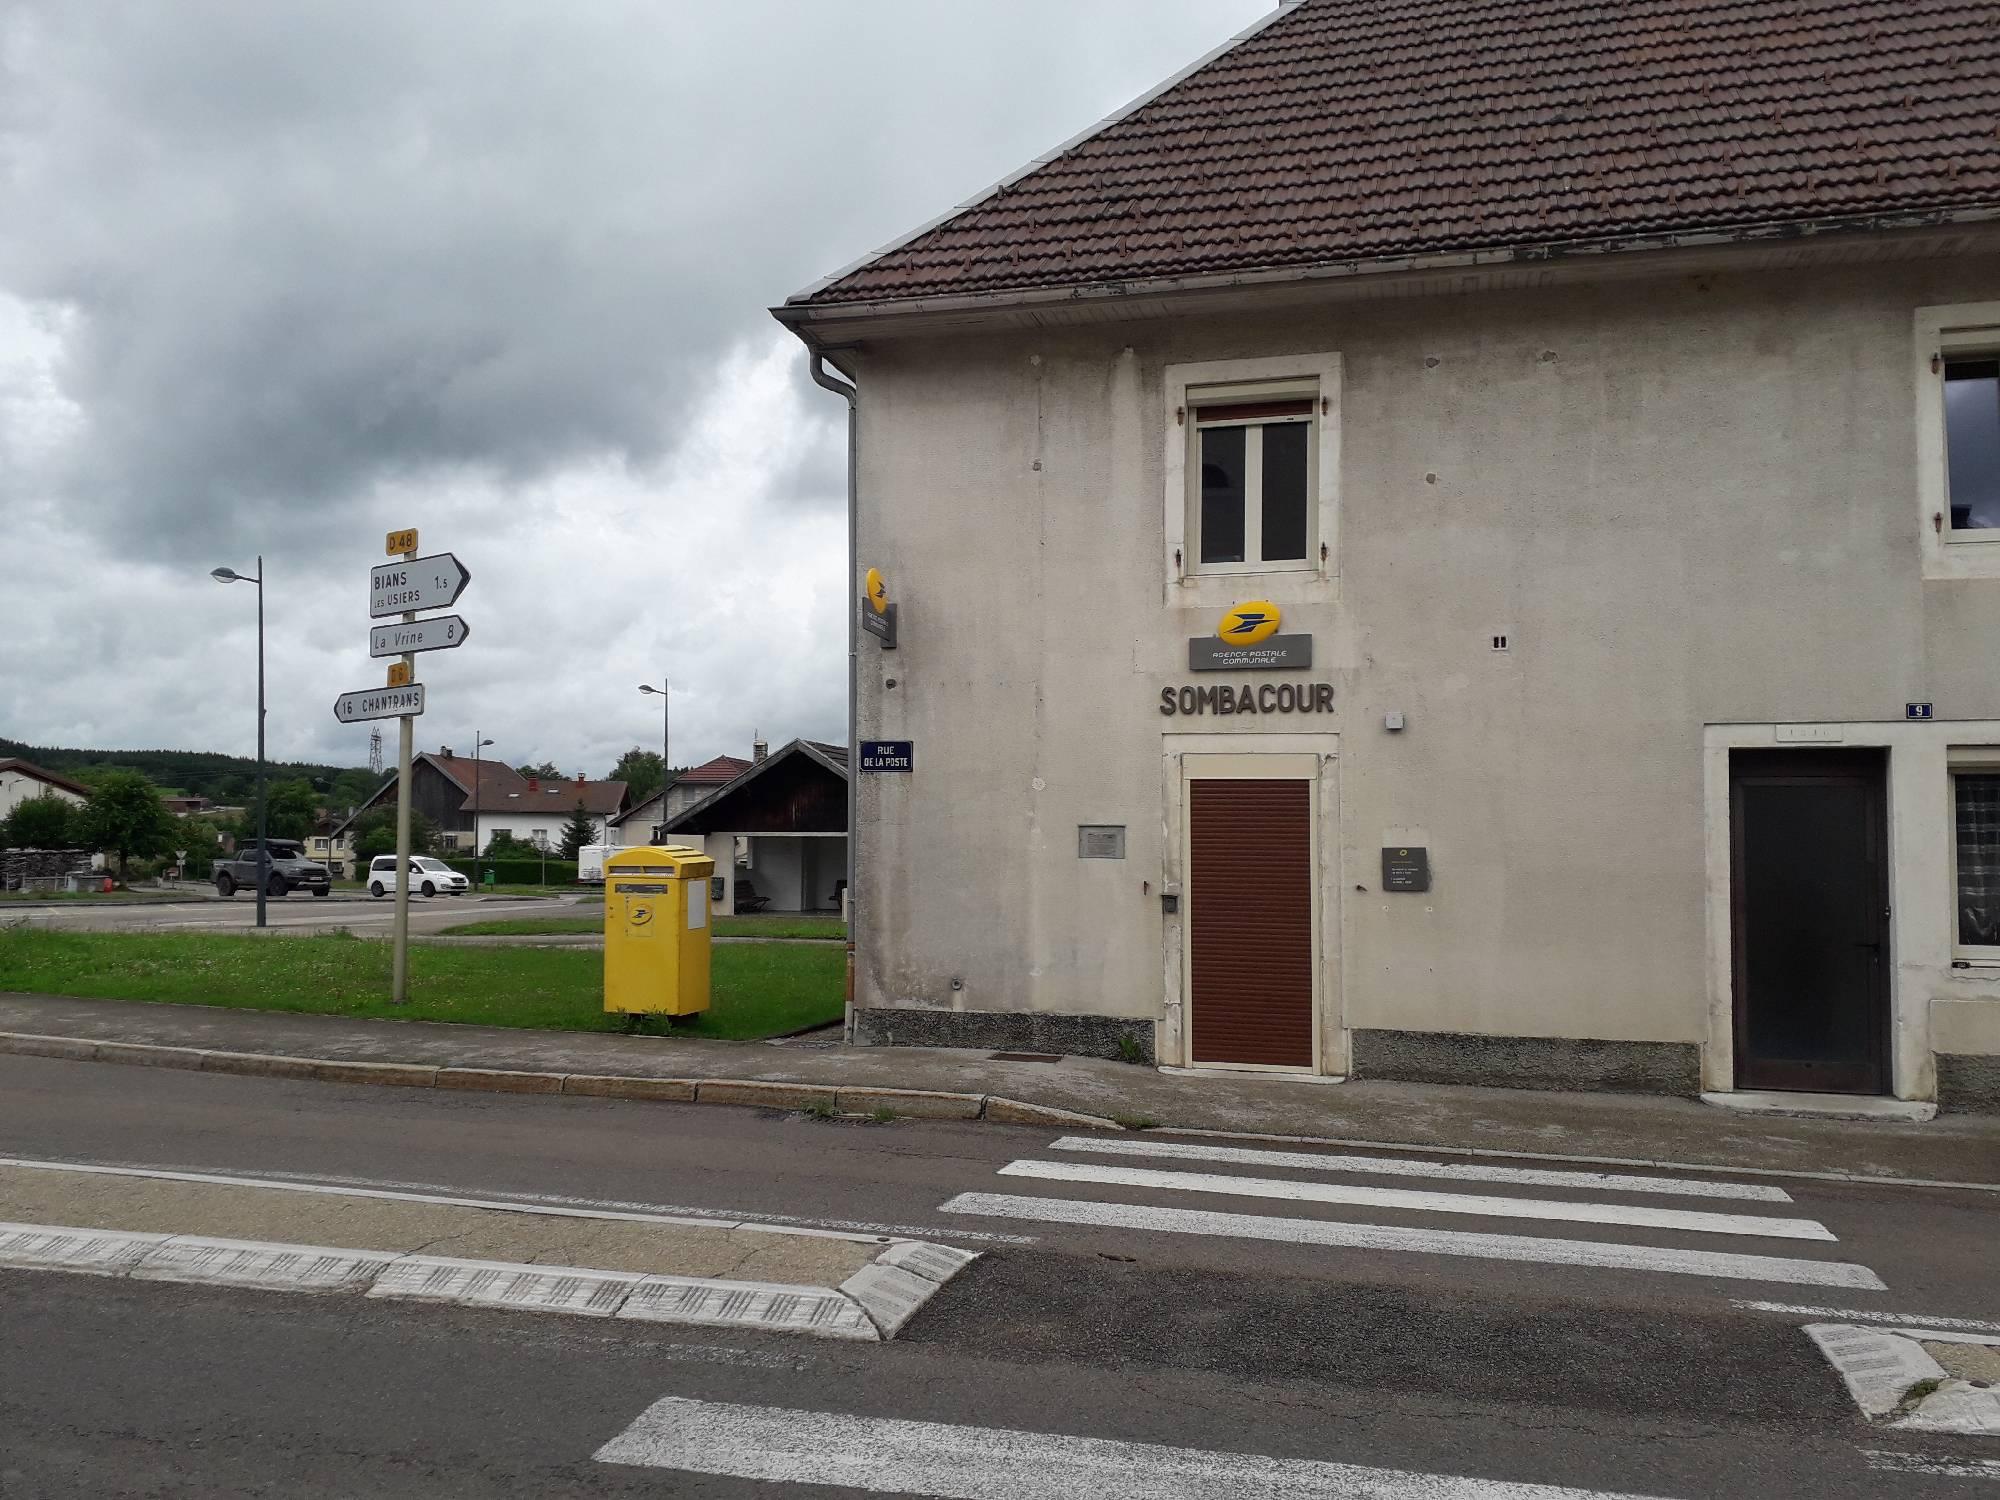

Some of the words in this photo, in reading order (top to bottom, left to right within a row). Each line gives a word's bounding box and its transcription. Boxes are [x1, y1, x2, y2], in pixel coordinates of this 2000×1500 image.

[389, 536, 395, 550] D
[399, 533, 413, 547] 48
[374, 571, 407, 590] BIANS
[374, 599, 385, 608] LES
[387, 590, 420, 606] USIERS
[374, 635, 386, 649] La
[394, 630, 423, 648] Vrine
[447, 624, 454, 639] 8
[1222, 656, 1277, 665] COMMUNALE
[342, 701, 353, 715] 16
[362, 692, 419, 713] CHANTRANS
[1159, 683, 1335, 716] SOMBACOUR
[1915, 705, 1923, 716] 9
[877, 746, 895, 755] RUE
[864, 757, 873, 767] DE
[875, 757, 884, 767] LA
[885, 757, 908, 767] POSTE
